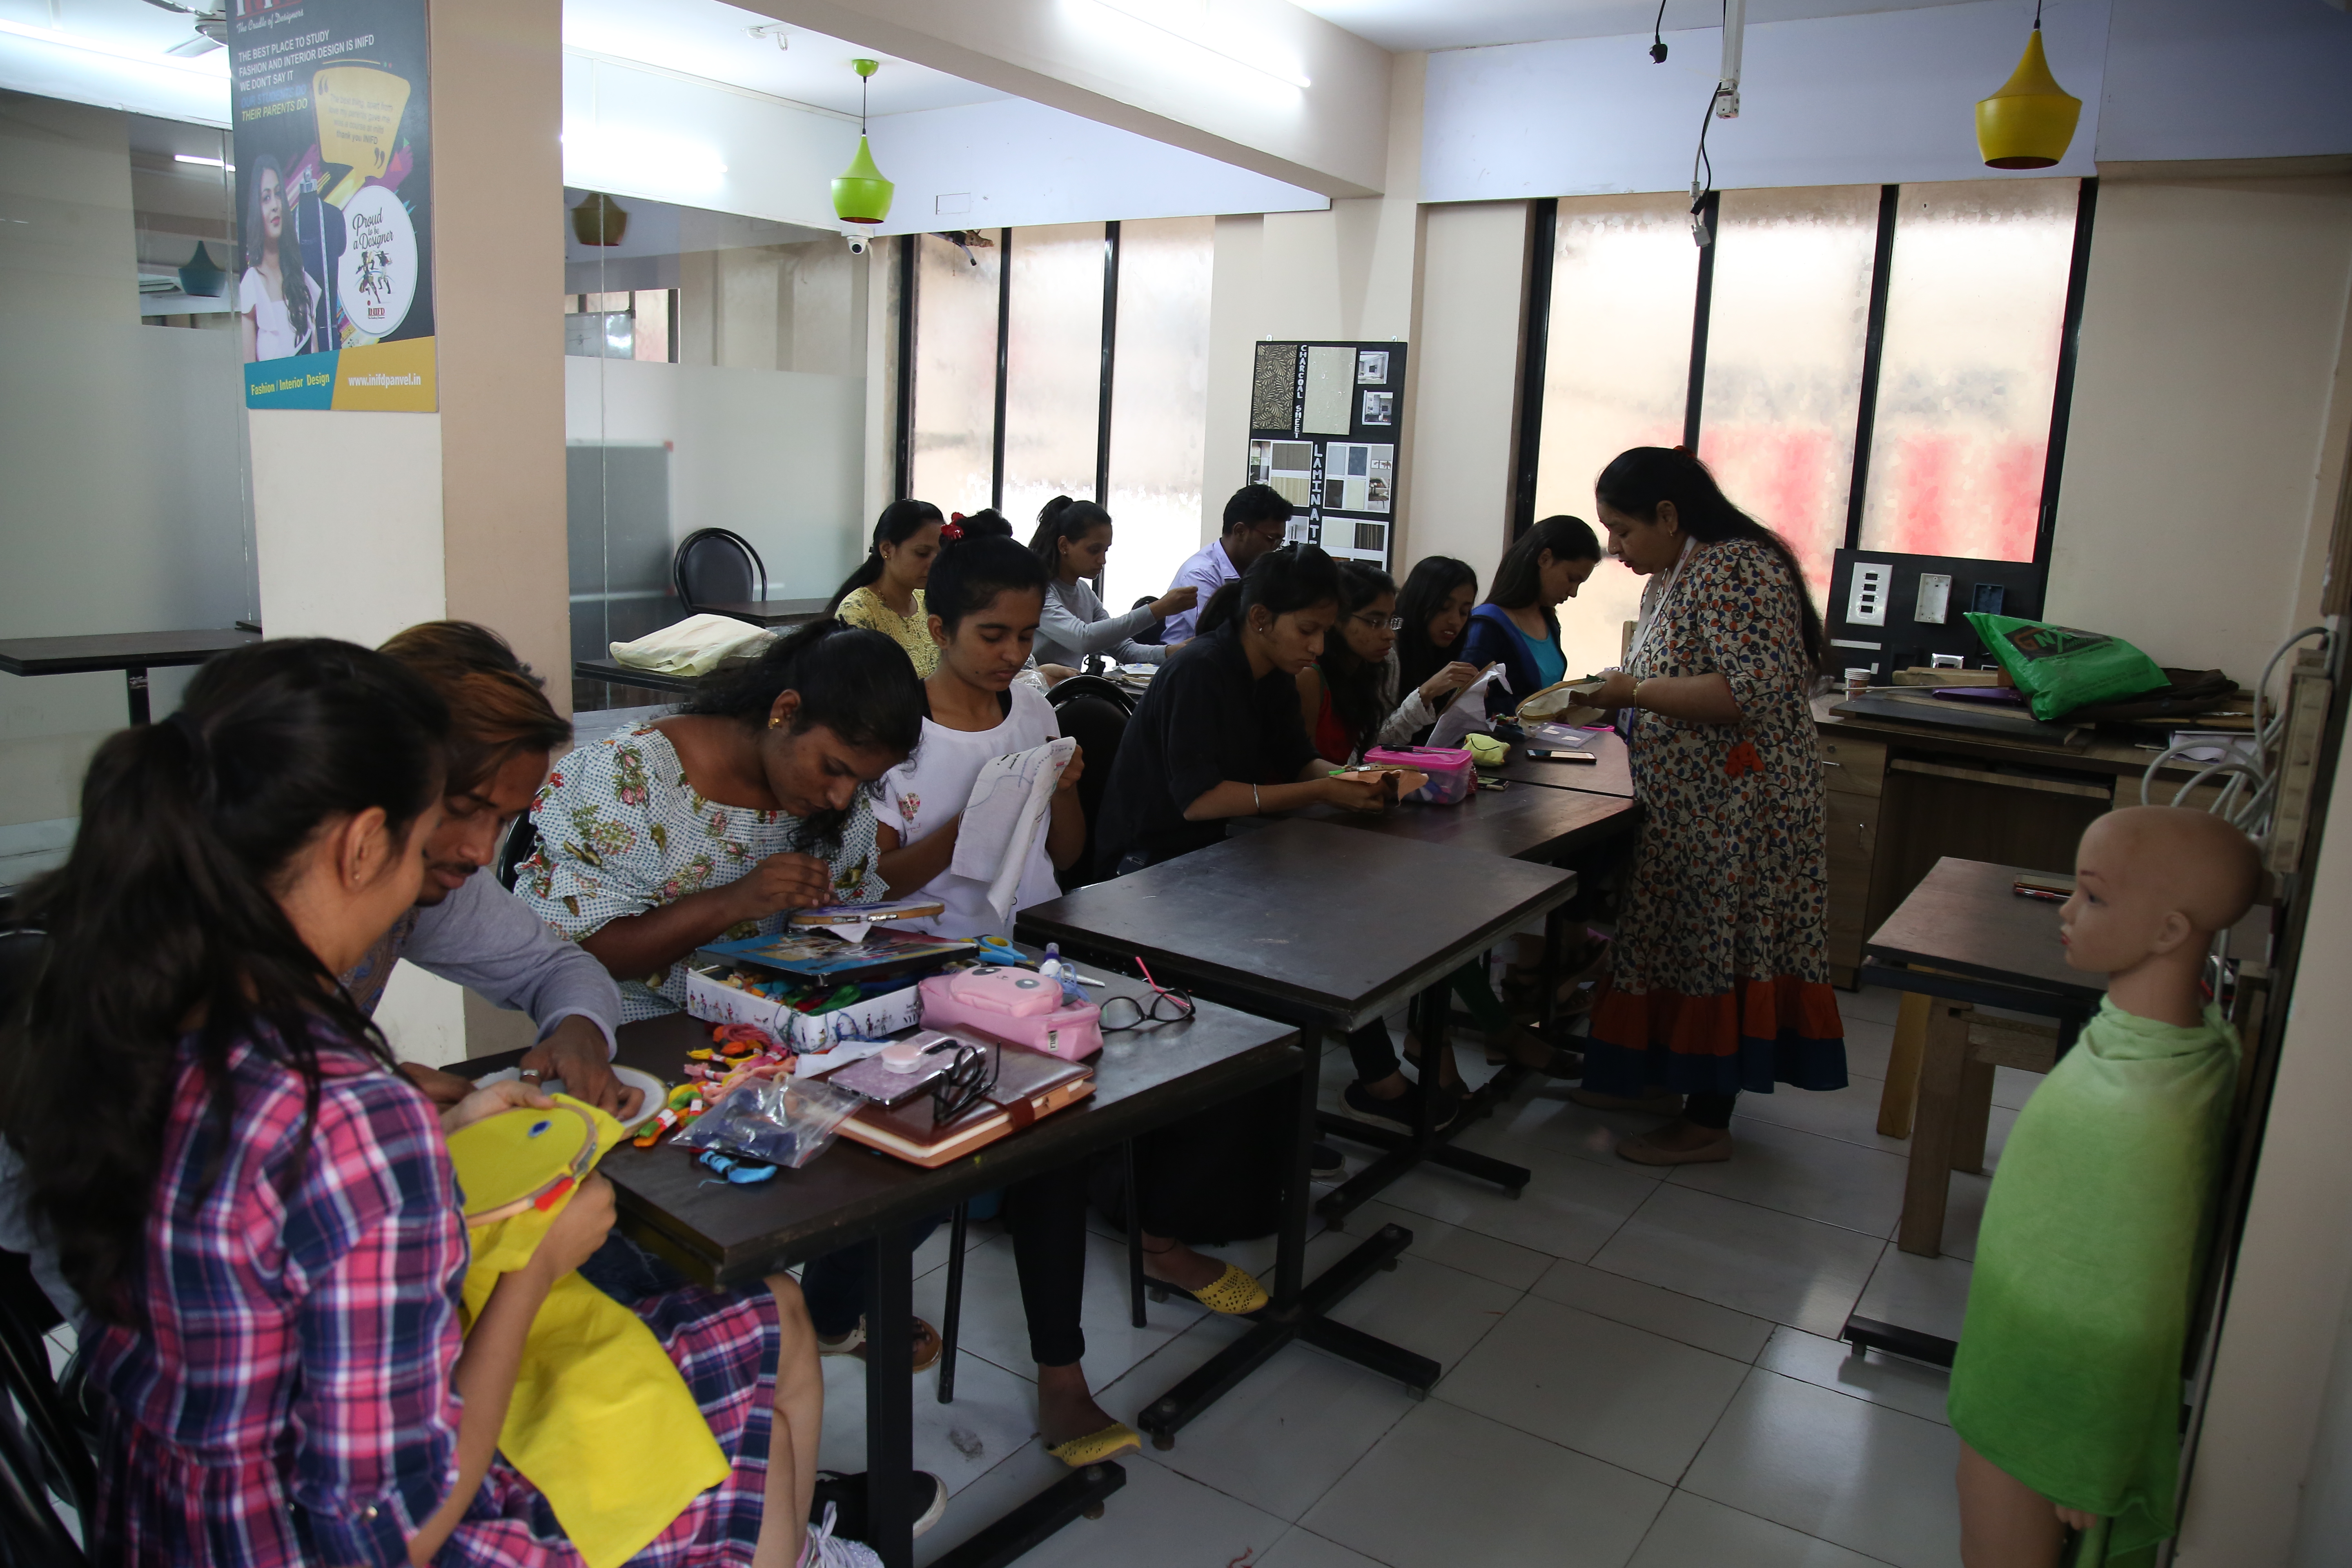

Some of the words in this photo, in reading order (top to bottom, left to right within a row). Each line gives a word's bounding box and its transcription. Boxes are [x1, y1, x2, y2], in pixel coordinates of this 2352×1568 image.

[268, 14, 274, 29] of
[238, 51, 252, 62] THE
[253, 45, 270, 59] BEST
[272, 40, 294, 54] PLACE
[295, 37, 305, 48] TO
[306, 30, 330, 45] STUDY
[239, 62, 267, 76] FASHION
[269, 58, 282, 70] AND
[284, 49, 316, 67] INTERIOR
[318, 42, 345, 58] DESIGN
[347, 40, 353, 51] IS
[355, 34, 374, 49] INIFD
[240, 81, 250, 91] WE
[252, 76, 272, 89] DON'T
[273, 72, 286, 85] SAY
[287, 70, 294, 81] IT
[296, 85, 306, 96] DO
[242, 108, 261, 121] THEIR
[263, 101, 295, 117] PARENTS
[297, 98, 307, 110] DO
[352, 207, 383, 236] Proud
[353, 241, 358, 250] a
[359, 230, 393, 249] Designer
[251, 382, 275, 395] Fashion
[279, 377, 303, 391] Interior
[307, 372, 330, 386] Design
[348, 373, 421, 389] www.inifdpanvel.in
[1297, 345, 1307, 399] CHARCOAL
[1309, 444, 1323, 544] LAMINAT
